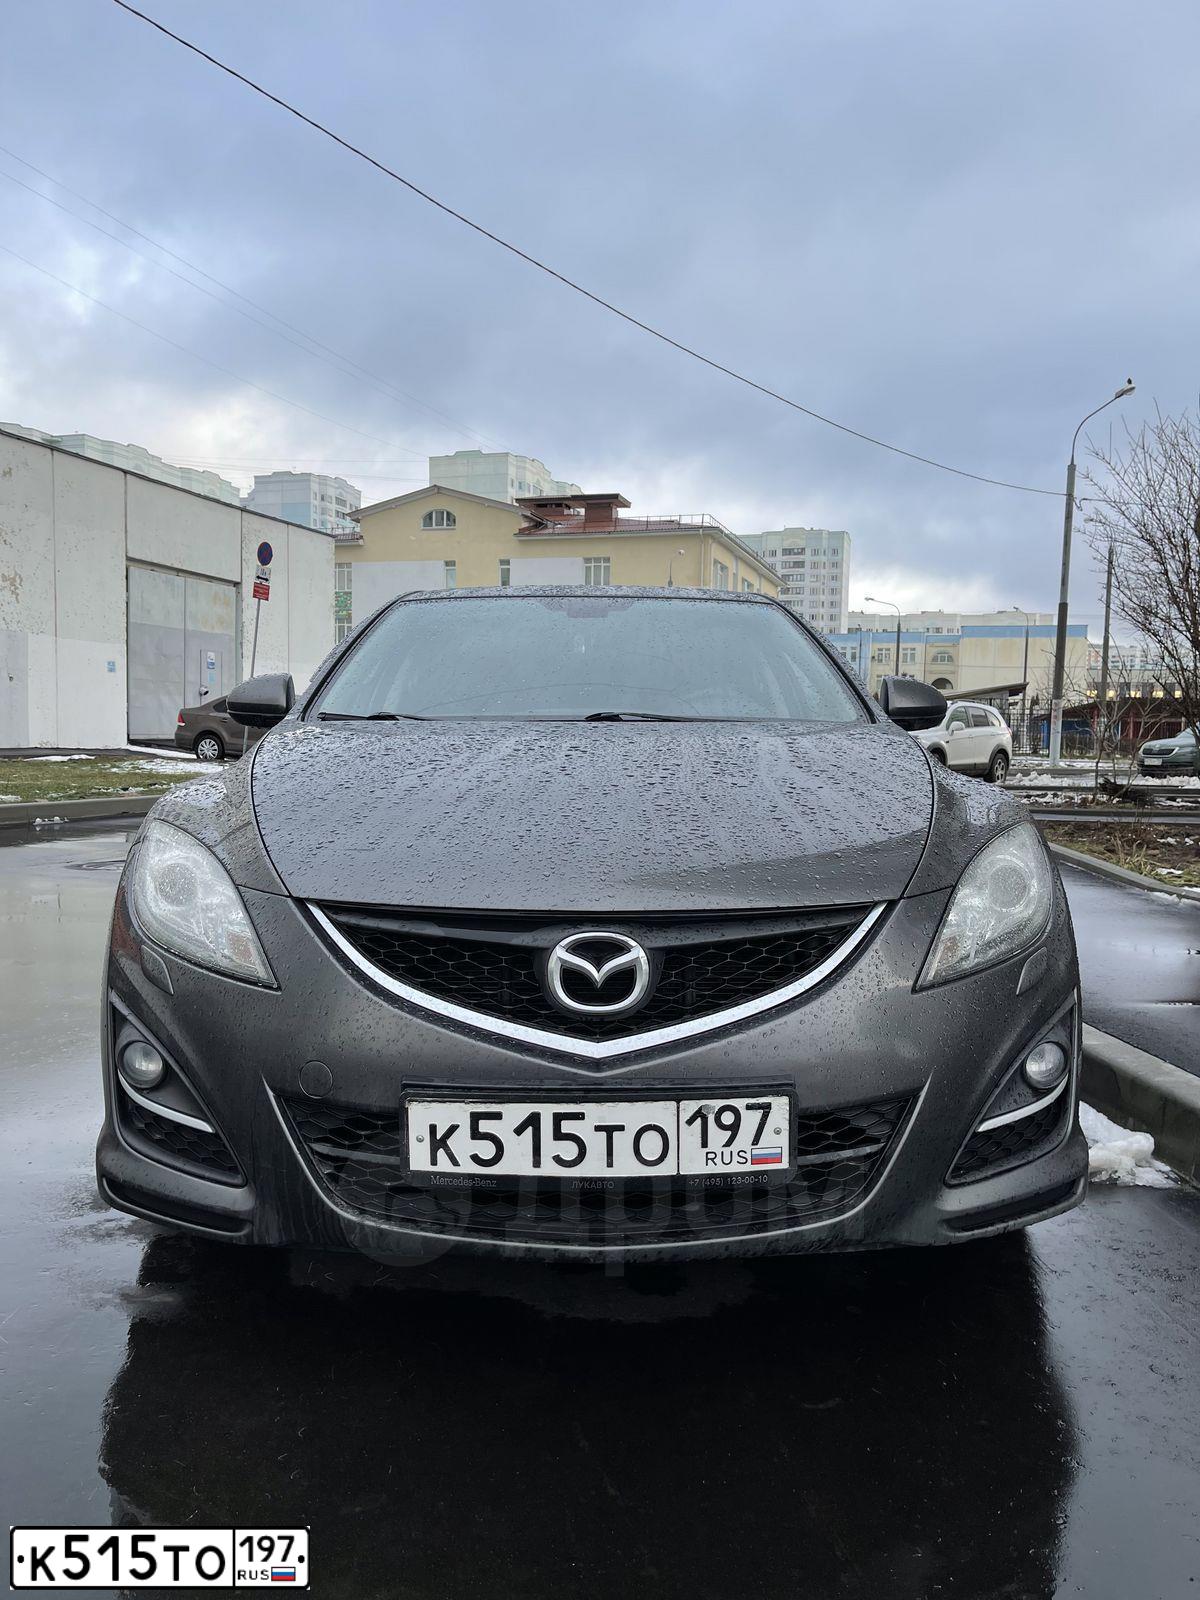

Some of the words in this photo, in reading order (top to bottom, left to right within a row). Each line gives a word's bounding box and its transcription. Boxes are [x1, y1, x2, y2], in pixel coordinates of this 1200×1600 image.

[685, 1101, 773, 1149] 197
[704, 1149, 748, 1167] RUS
[430, 1175, 497, 1188] Mercedes-Benz
[571, 1180, 615, 1189] ЛУКАВТО
